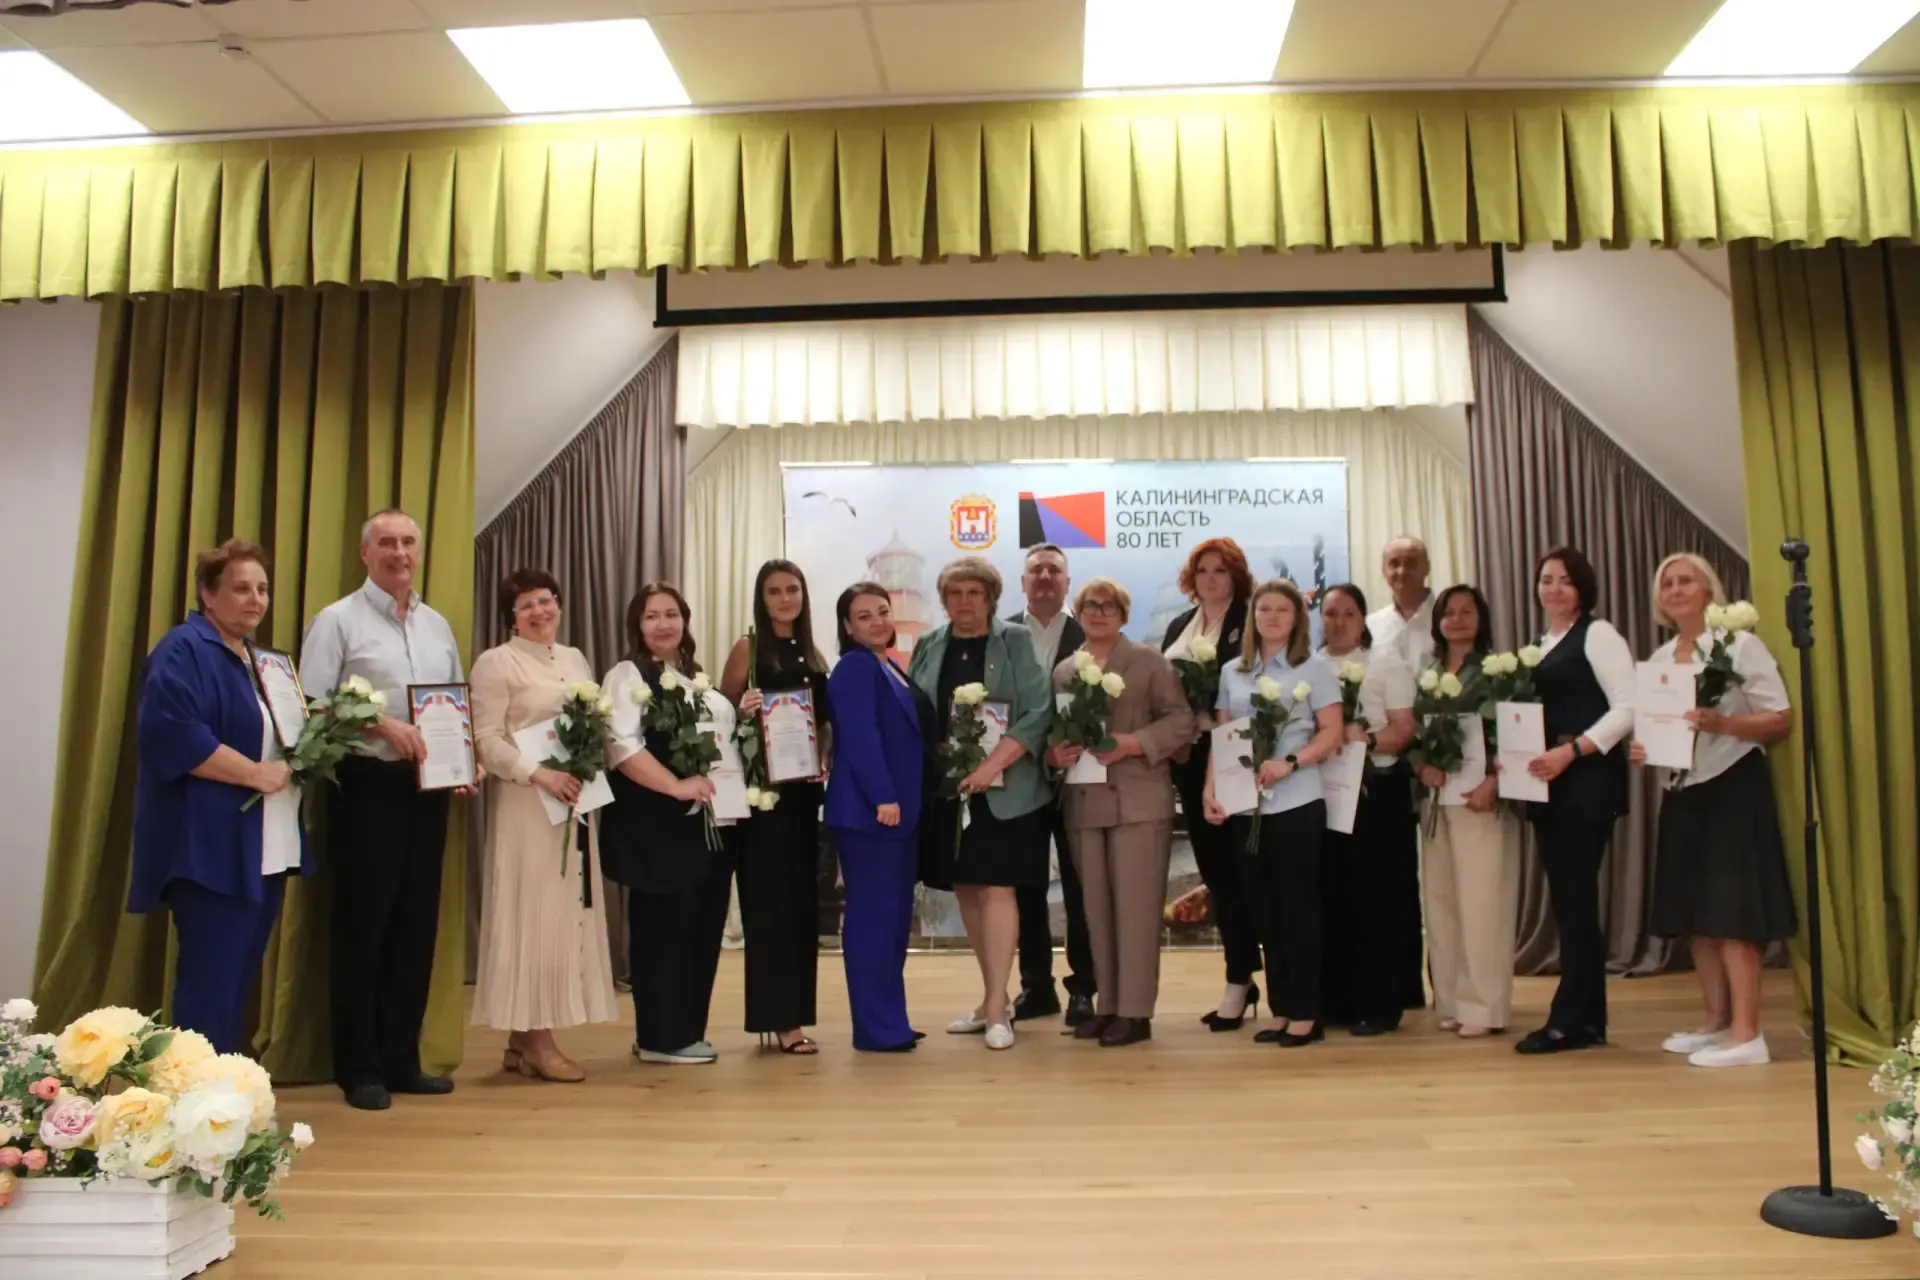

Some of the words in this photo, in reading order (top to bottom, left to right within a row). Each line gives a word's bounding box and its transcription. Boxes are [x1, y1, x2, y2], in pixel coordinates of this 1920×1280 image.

[1116, 488, 1324, 507] КАЛИНИНГРАДСКАЯ
[1116, 510, 1210, 527] ОБЛАСТЬ
[1116, 532, 1141, 549] 80
[1146, 532, 1182, 549] ЛЕТ
